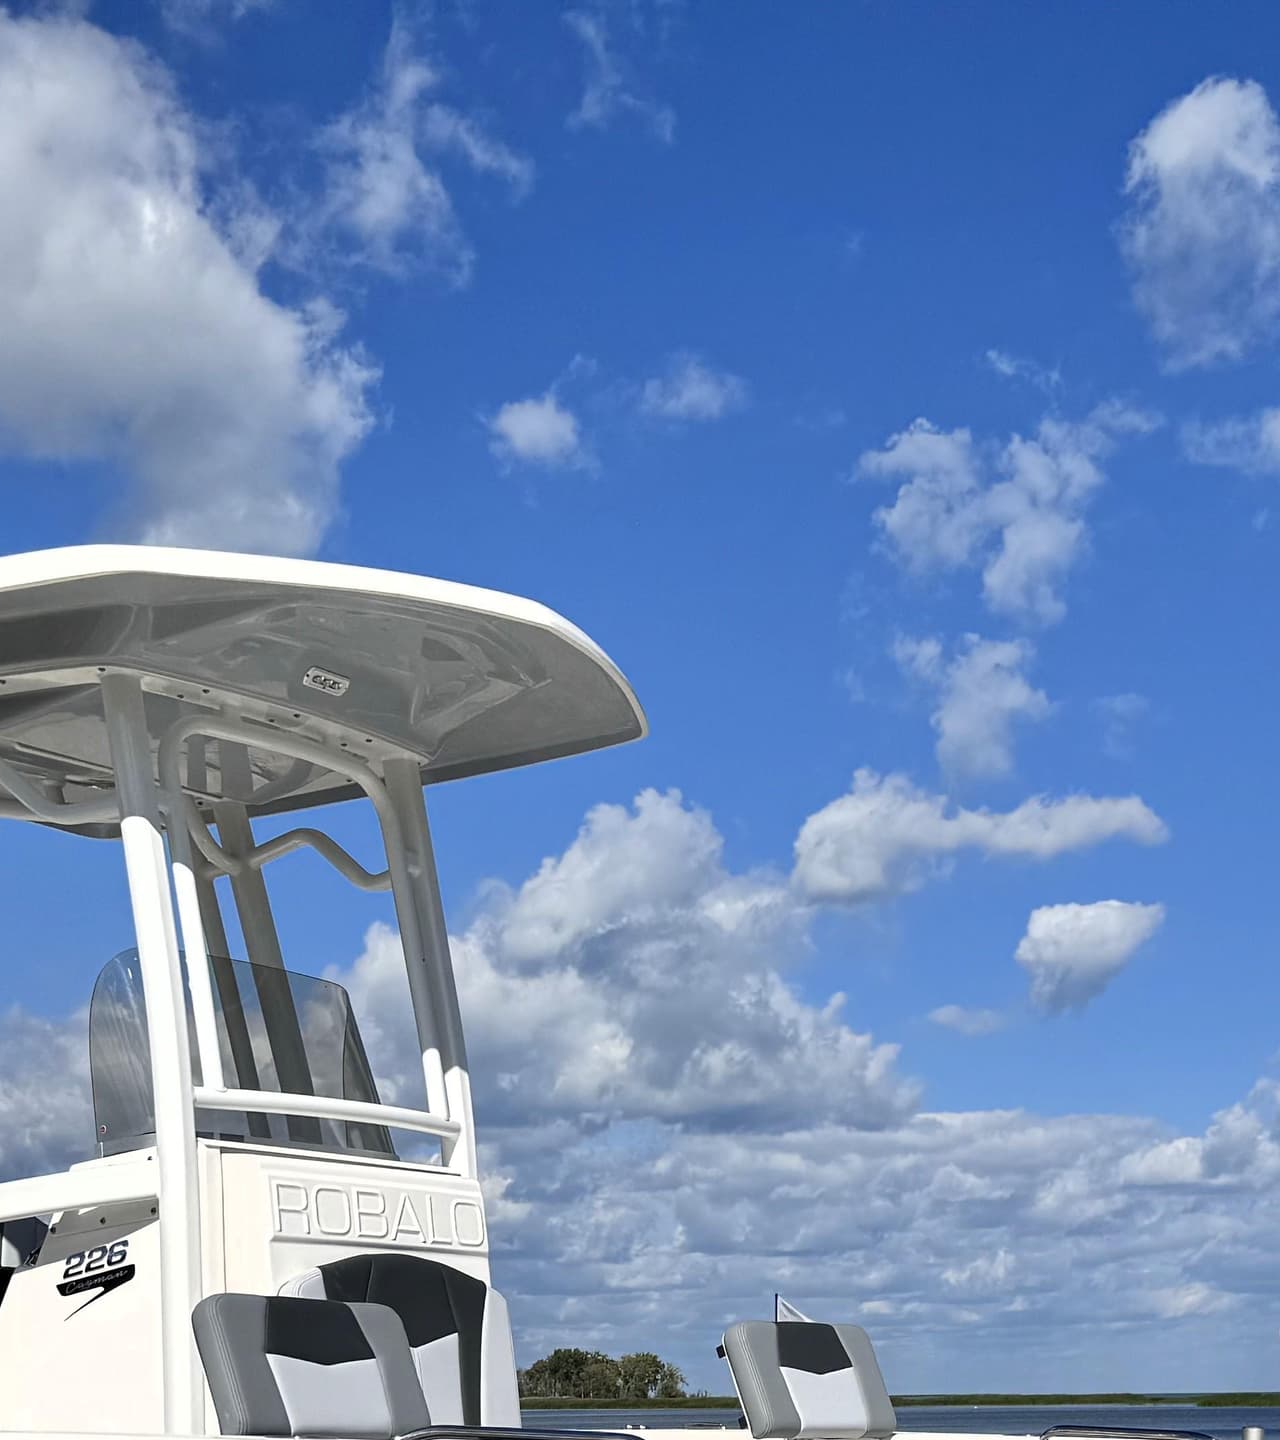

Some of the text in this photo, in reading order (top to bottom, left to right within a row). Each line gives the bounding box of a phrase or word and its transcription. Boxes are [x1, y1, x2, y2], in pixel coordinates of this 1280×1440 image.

[275, 1183, 485, 1247] ROBALO
[63, 1239, 129, 1280] 226
[65, 1269, 129, 1294] Cayman
